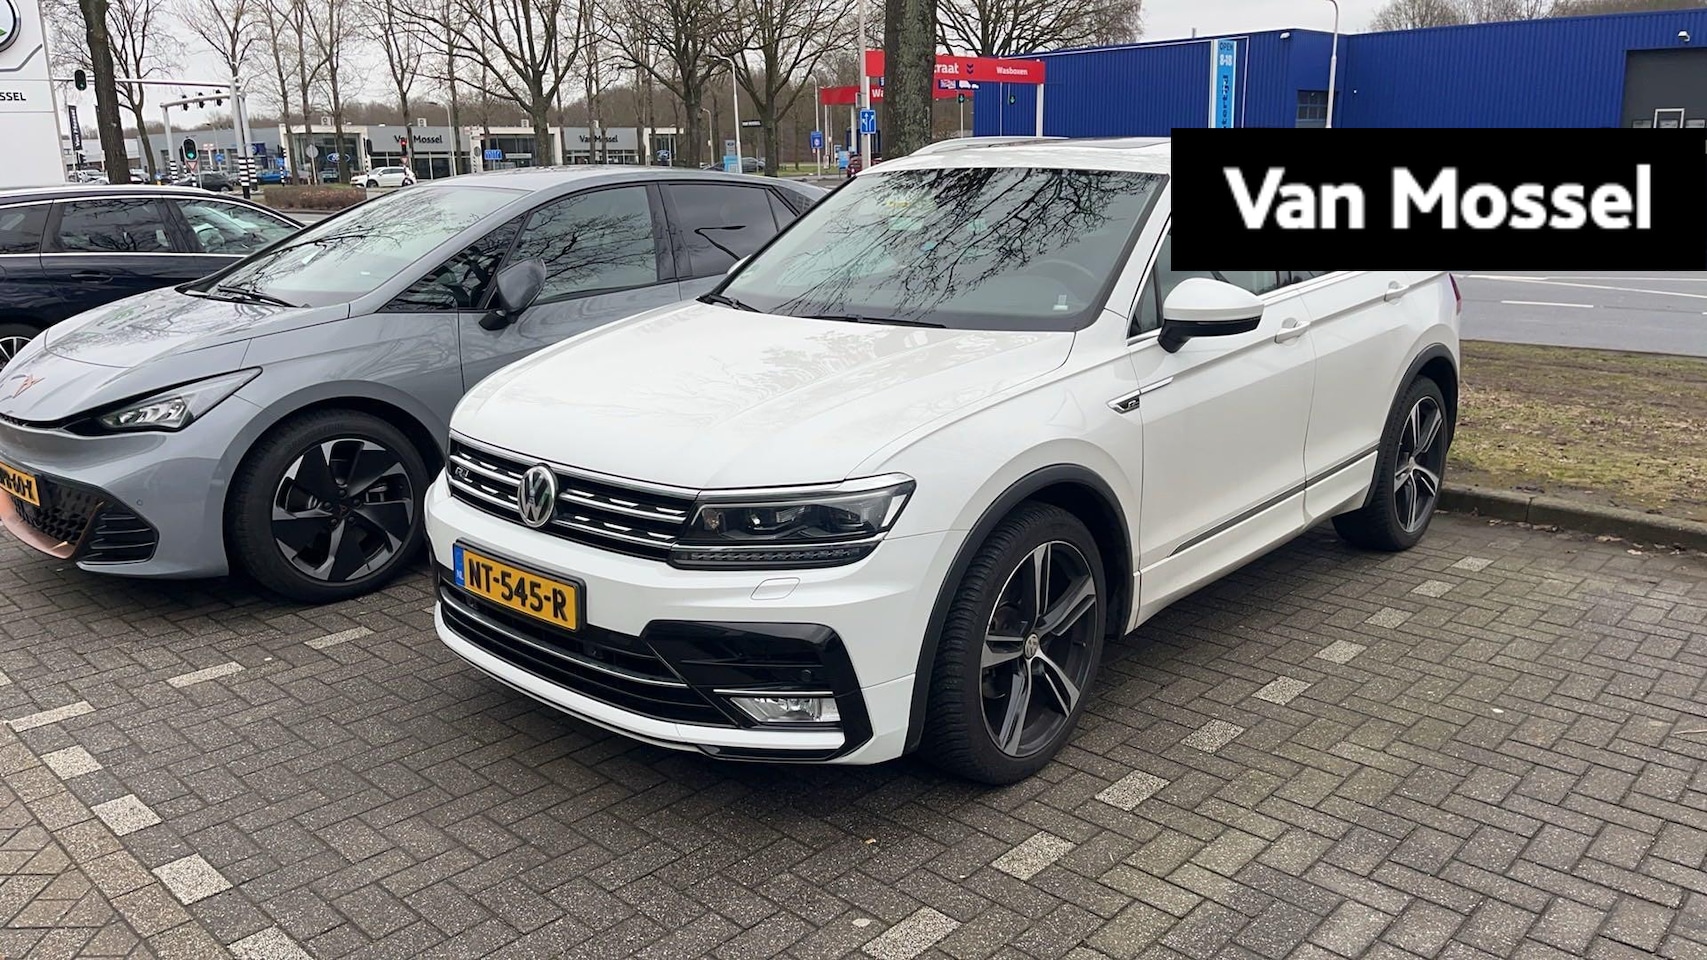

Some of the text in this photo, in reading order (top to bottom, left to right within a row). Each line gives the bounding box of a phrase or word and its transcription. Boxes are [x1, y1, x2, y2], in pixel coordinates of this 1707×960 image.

[1219, 42, 1233, 50] OPEN
[1219, 54, 1232, 66] 8-18
[996, 66, 1028, 76] Wasboxen
[413, 134, 443, 143] Mossel
[468, 558, 568, 622] NT-545-R
